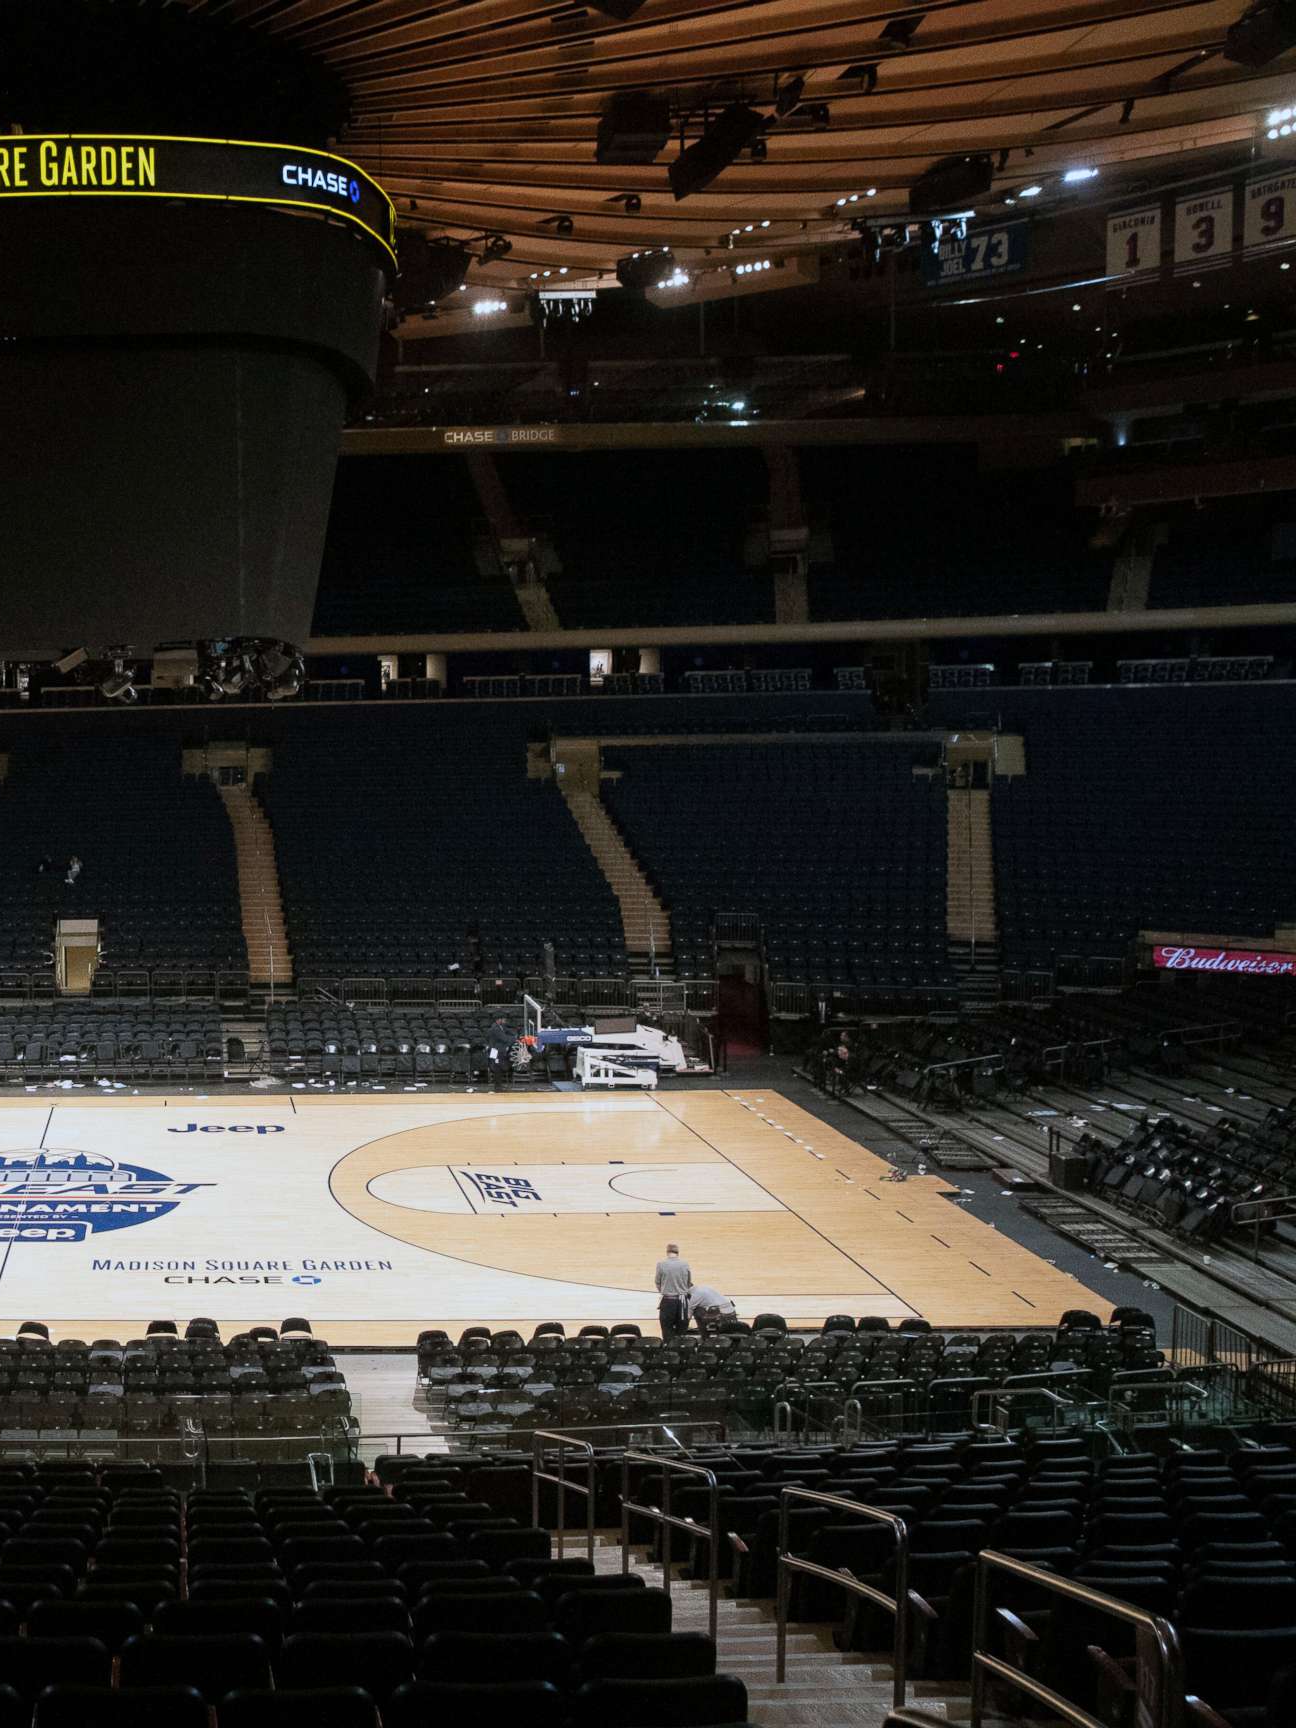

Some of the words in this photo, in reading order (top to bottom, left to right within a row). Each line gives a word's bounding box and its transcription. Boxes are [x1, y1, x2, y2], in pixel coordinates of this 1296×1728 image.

[39, 140, 157, 188] GARDEN
[282, 164, 349, 197] CHASE
[1261, 196, 1285, 237] 9
[1191, 215, 1216, 254] 3
[969, 231, 1009, 272] 73
[1125, 232, 1141, 269] 1
[444, 431, 494, 443] CHASE
[511, 430, 557, 441] BRIDGE
[1160, 946, 1294, 975] Budweiser
[167, 1123, 285, 1134] Jeep
[0, 1183, 218, 1195] EAST
[474, 1173, 519, 1208] EAST
[502, 1176, 543, 1201] BIG
[92, 1259, 196, 1271] MADISON
[205, 1259, 294, 1271] SQUARE
[303, 1259, 393, 1271] GARDEN
[163, 1276, 284, 1285] CHASE
